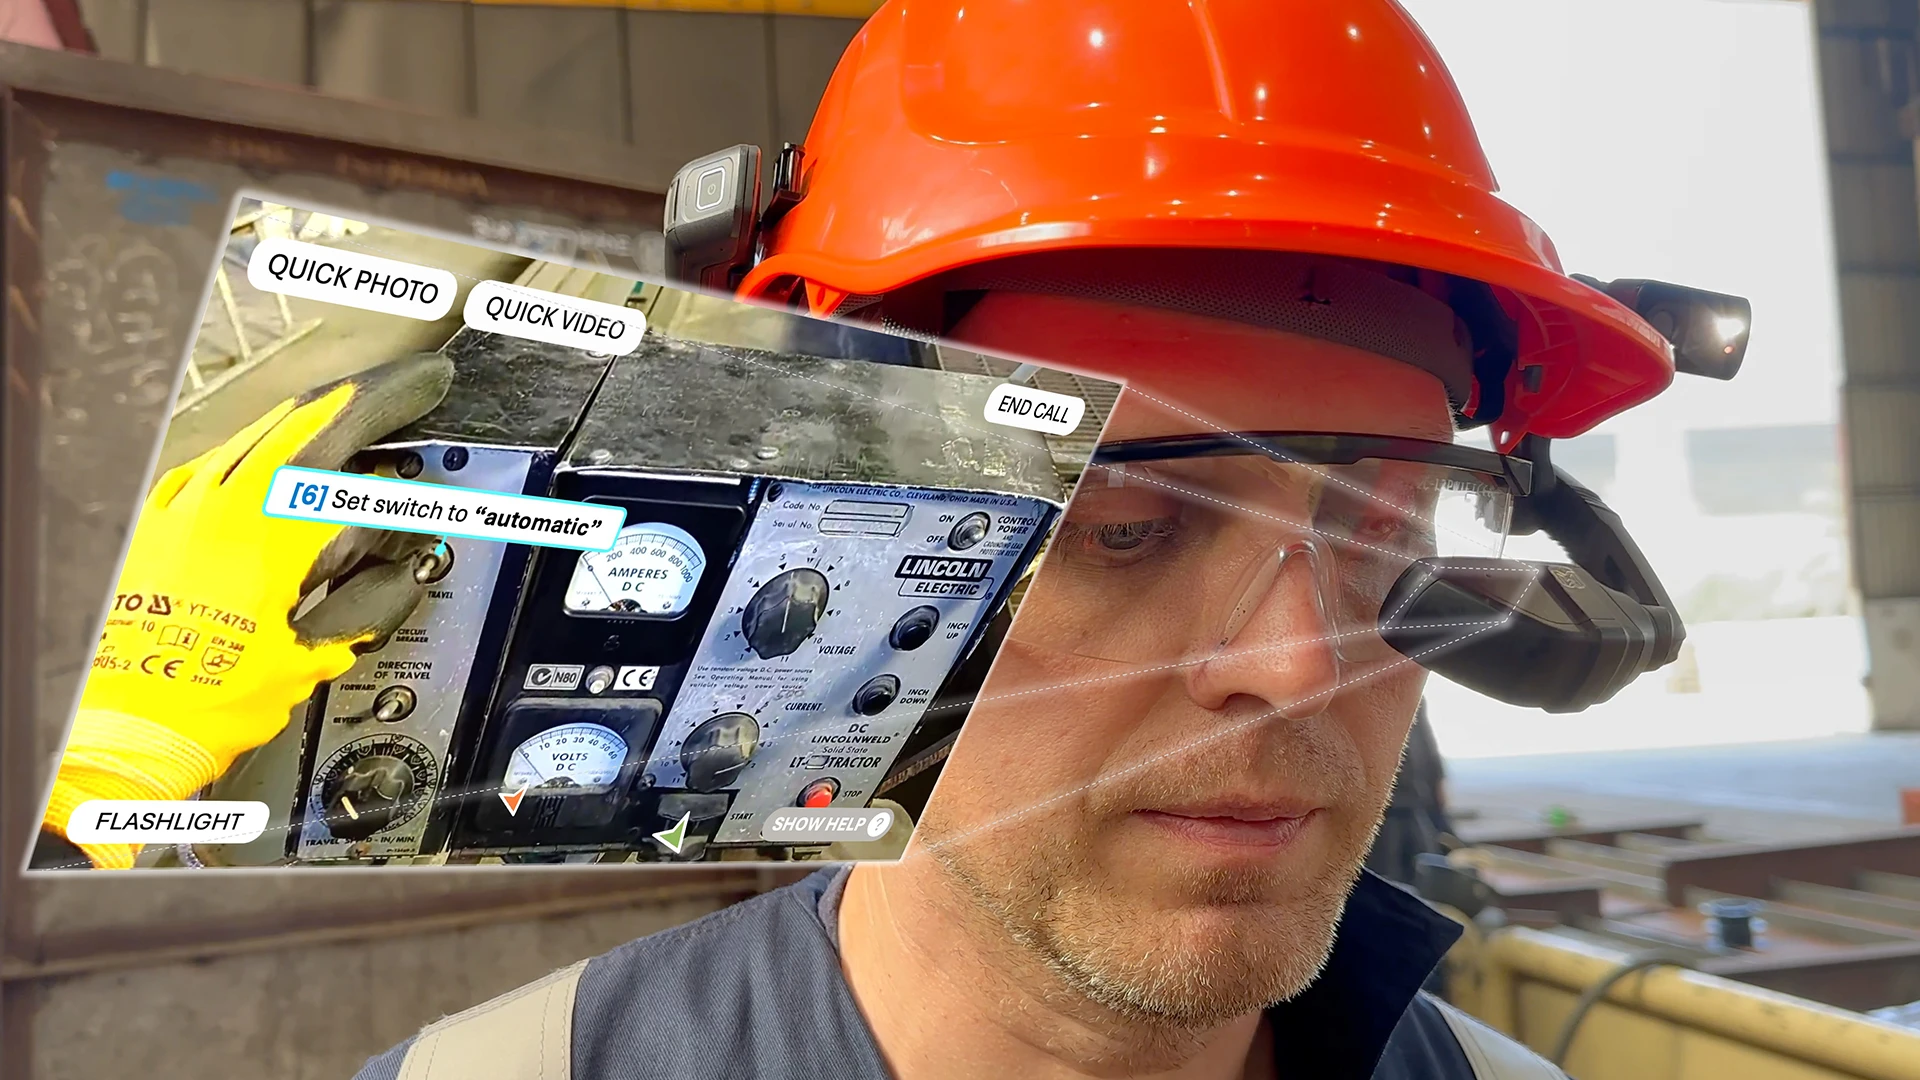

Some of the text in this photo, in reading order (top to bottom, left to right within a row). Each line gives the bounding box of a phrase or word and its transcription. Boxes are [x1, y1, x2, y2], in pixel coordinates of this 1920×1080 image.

[822, 486, 855, 495] LINCOLN
[855, 488, 888, 497] ELECTRIC
[949, 494, 968, 503] OHIO
[968, 495, 989, 504] MADE
[990, 496, 999, 505] IN
[783, 501, 822, 511] Code No.
[939, 514, 955, 523] ON
[997, 516, 1038, 527] CONTROL
[799, 520, 814, 529] No.
[996, 525, 1029, 534] POWER
[926, 535, 945, 543] OFF
[606, 546, 694, 583] 200 400 600 800 1000
[900, 558, 988, 578] LINCOLN
[608, 567, 669, 580] AMPERES
[914, 582, 980, 595] ELECTRIC
[427, 590, 454, 599] TRAVEL
[189, 601, 257, 634] YT-74753
[140, 619, 156, 633] 10
[946, 622, 969, 631] INCH
[946, 632, 959, 640] UP
[211, 636, 228, 647] EN
[818, 645, 857, 655] VOLTAGE
[377, 661, 432, 670] DIRECTION
[374, 671, 431, 680] OF TRAVEL
[553, 671, 577, 684] N80
[340, 683, 376, 691] FORWARD
[907, 688, 930, 696] INCH
[899, 697, 927, 705] DOWN
[784, 702, 822, 711] CURRENT
[848, 723, 869, 734] DC
[811, 735, 891, 744] LINCOLNWELD
[539, 736, 618, 760] 10 20 30 40 50 60
[822, 746, 868, 754] Solid State
[551, 752, 588, 761] VOLTS
[828, 756, 882, 768] TRACTOR
[842, 790, 862, 798] STOP
[730, 812, 754, 820] START
[305, 838, 340, 846] TRAVEL
[380, 836, 416, 845] IN/MIN.
